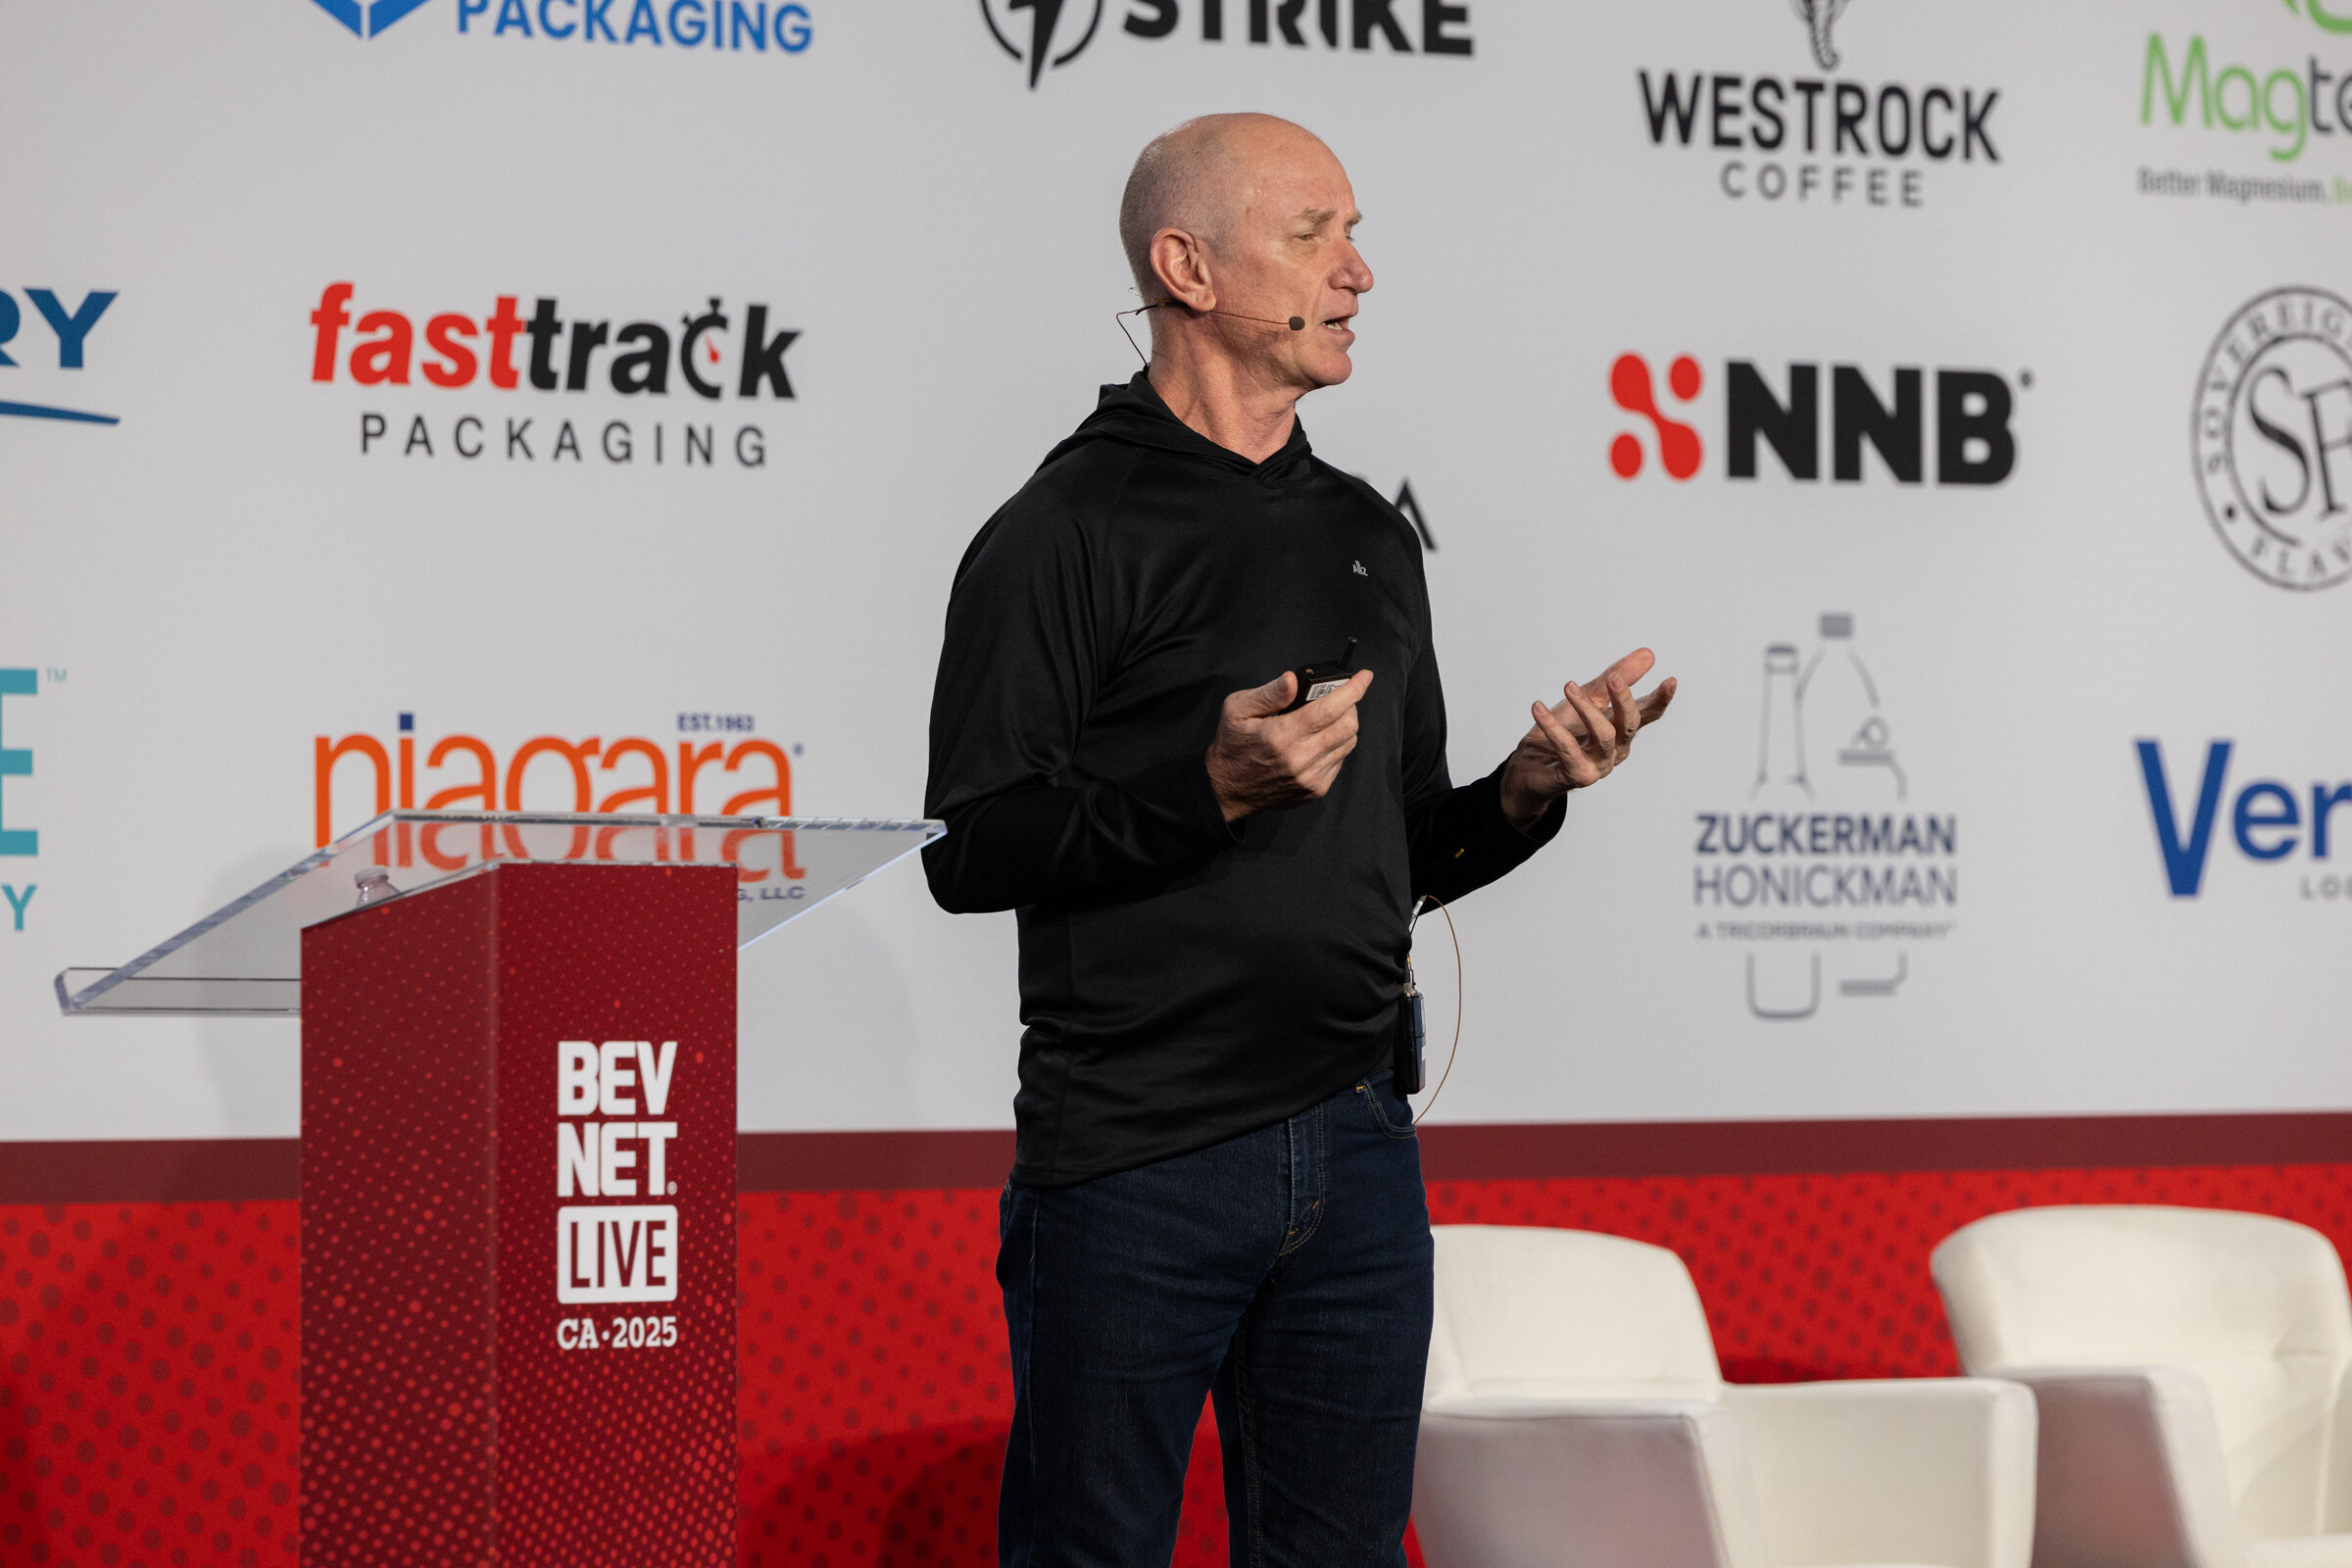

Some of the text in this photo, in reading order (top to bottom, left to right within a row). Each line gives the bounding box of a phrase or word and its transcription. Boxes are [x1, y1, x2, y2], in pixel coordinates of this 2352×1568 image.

[458, 0, 814, 55] PACKAGING
[1638, 69, 2001, 164] WESTROCK
[1720, 162, 1923, 207] COFFEE
[0, 287, 120, 370] Y
[362, 414, 766, 468] PACKAGING
[1726, 360, 2017, 487] NNB
[315, 712, 807, 883] niagara
[1695, 813, 1955, 856] ZUCKERMAN
[760, 886, 806, 901] LLC
[1693, 863, 1956, 907] HONICKMAN
[558, 1041, 678, 1115] BEV
[570, 1220, 666, 1289] LIVE
